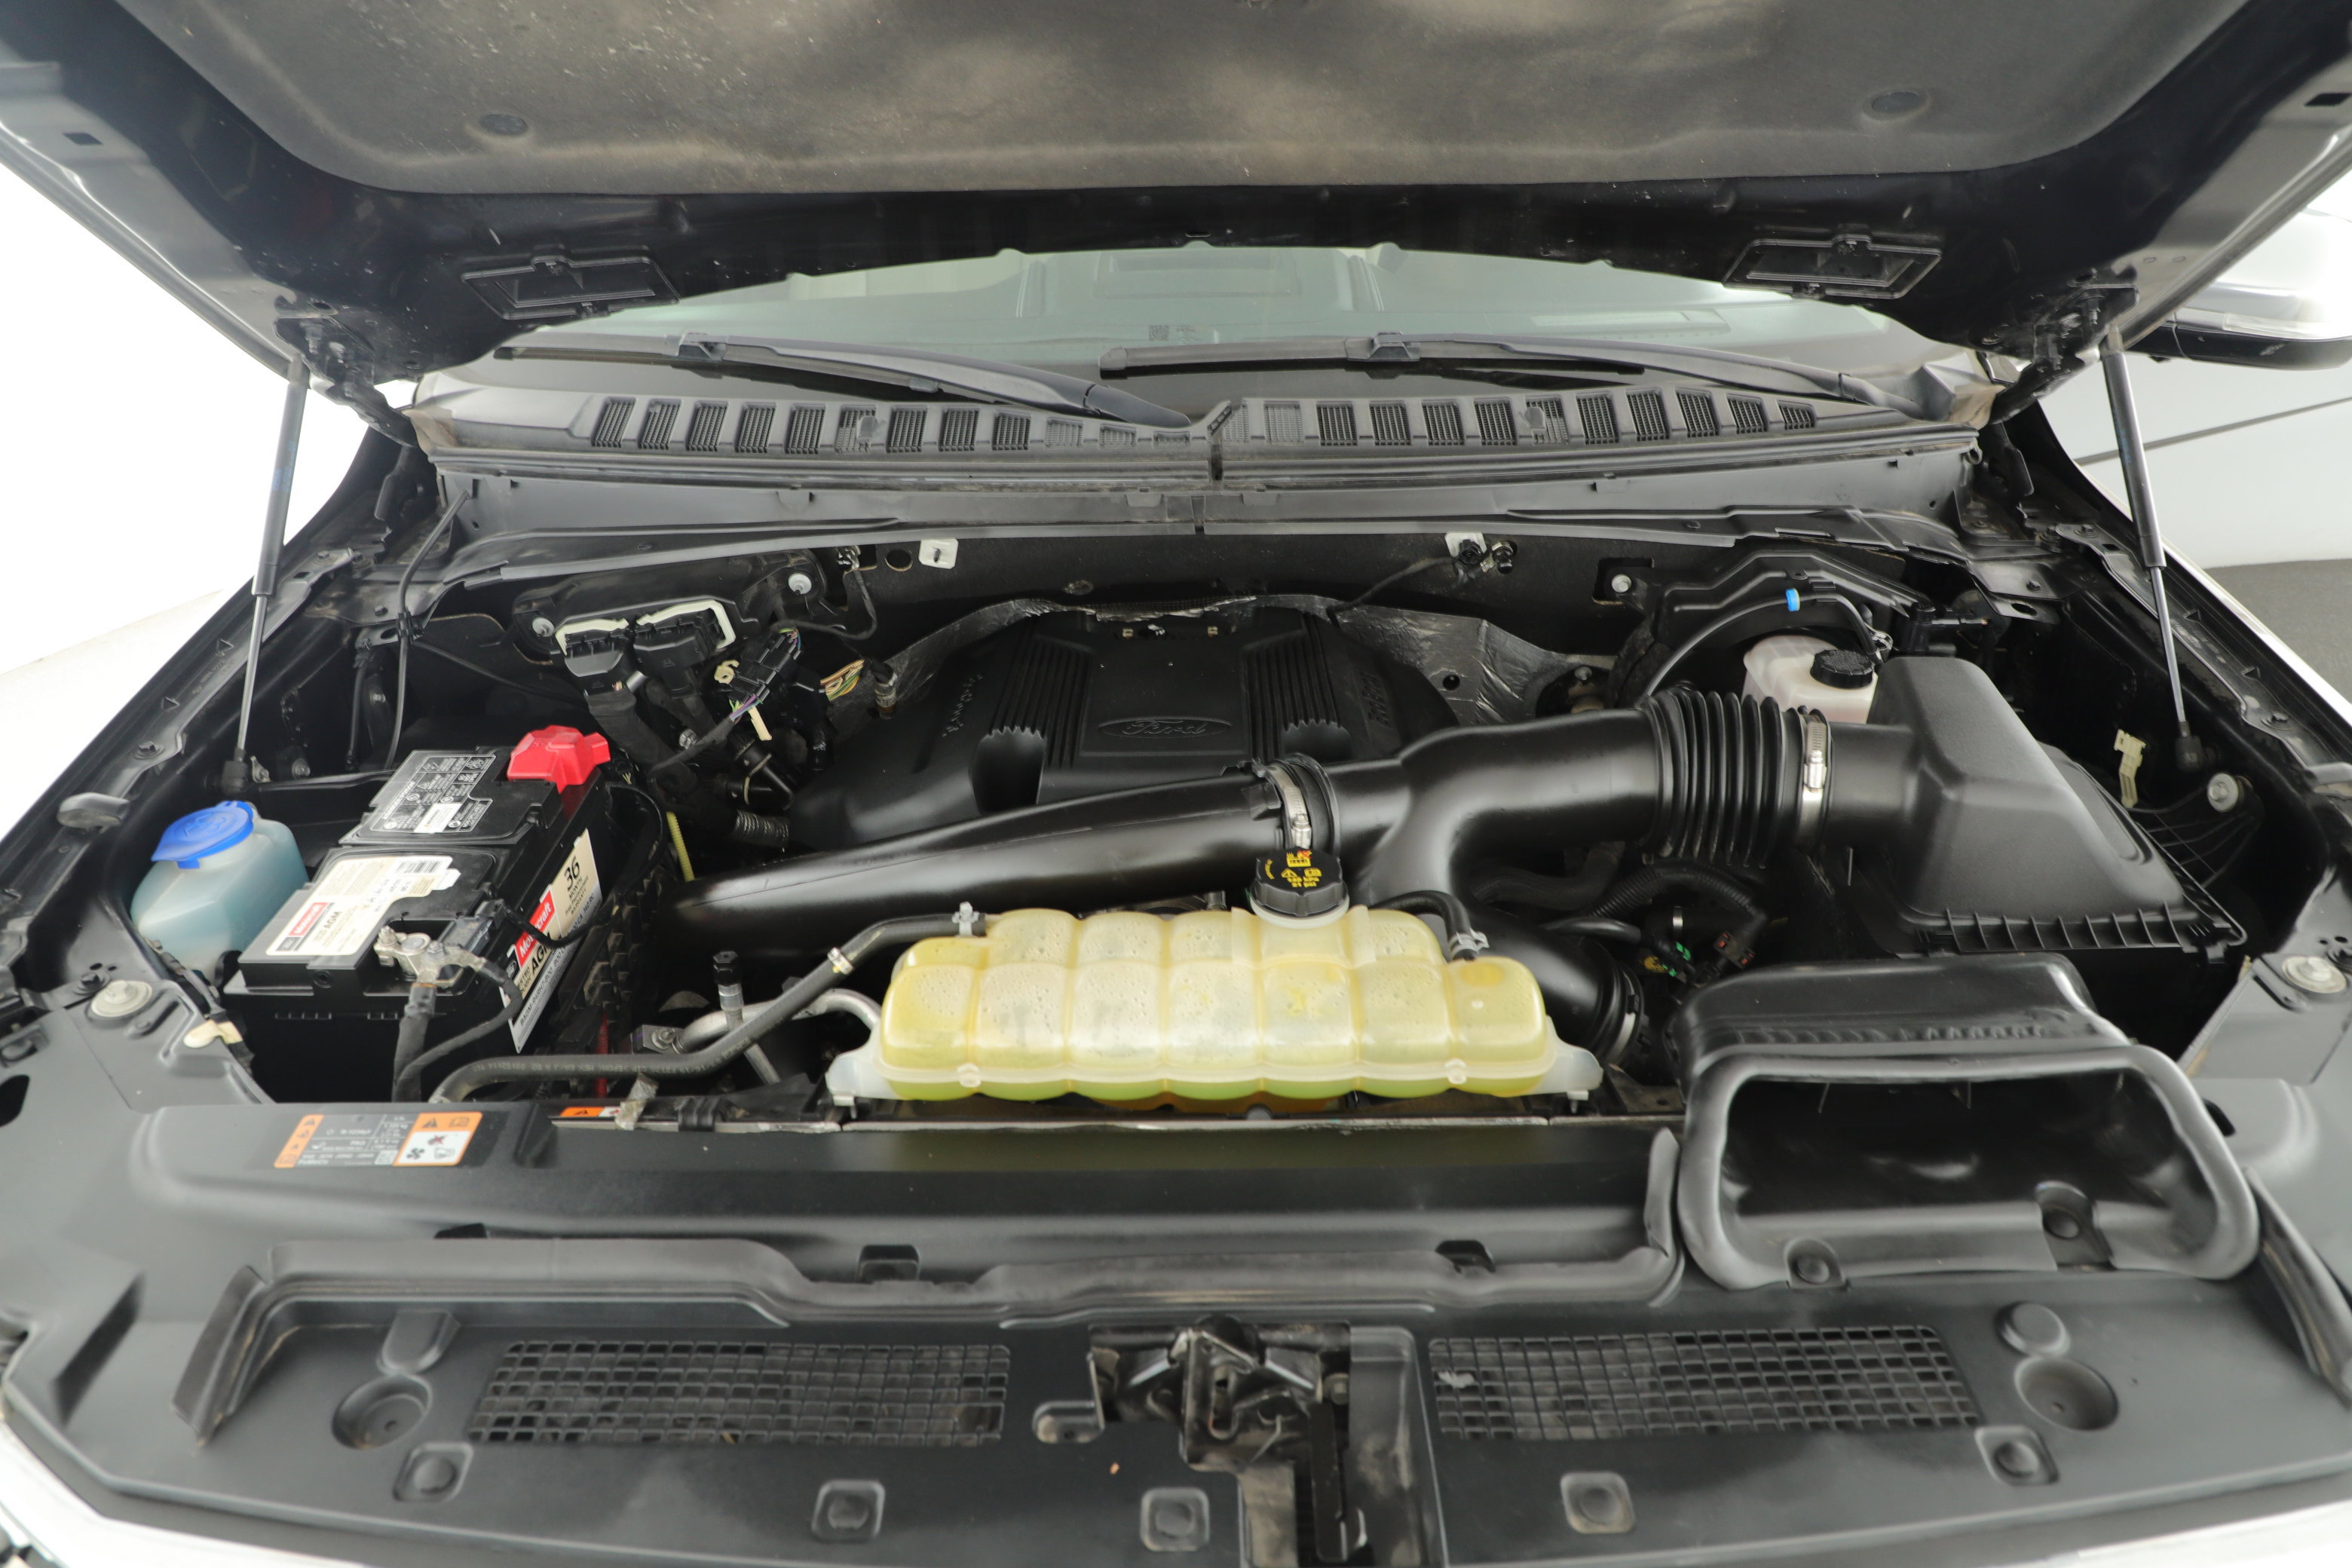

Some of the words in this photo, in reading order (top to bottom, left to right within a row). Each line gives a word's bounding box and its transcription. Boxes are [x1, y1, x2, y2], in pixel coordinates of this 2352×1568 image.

[1122, 720, 1208, 735] Ford
[564, 856, 580, 892] 36
[569, 877, 583, 900] MONTH
